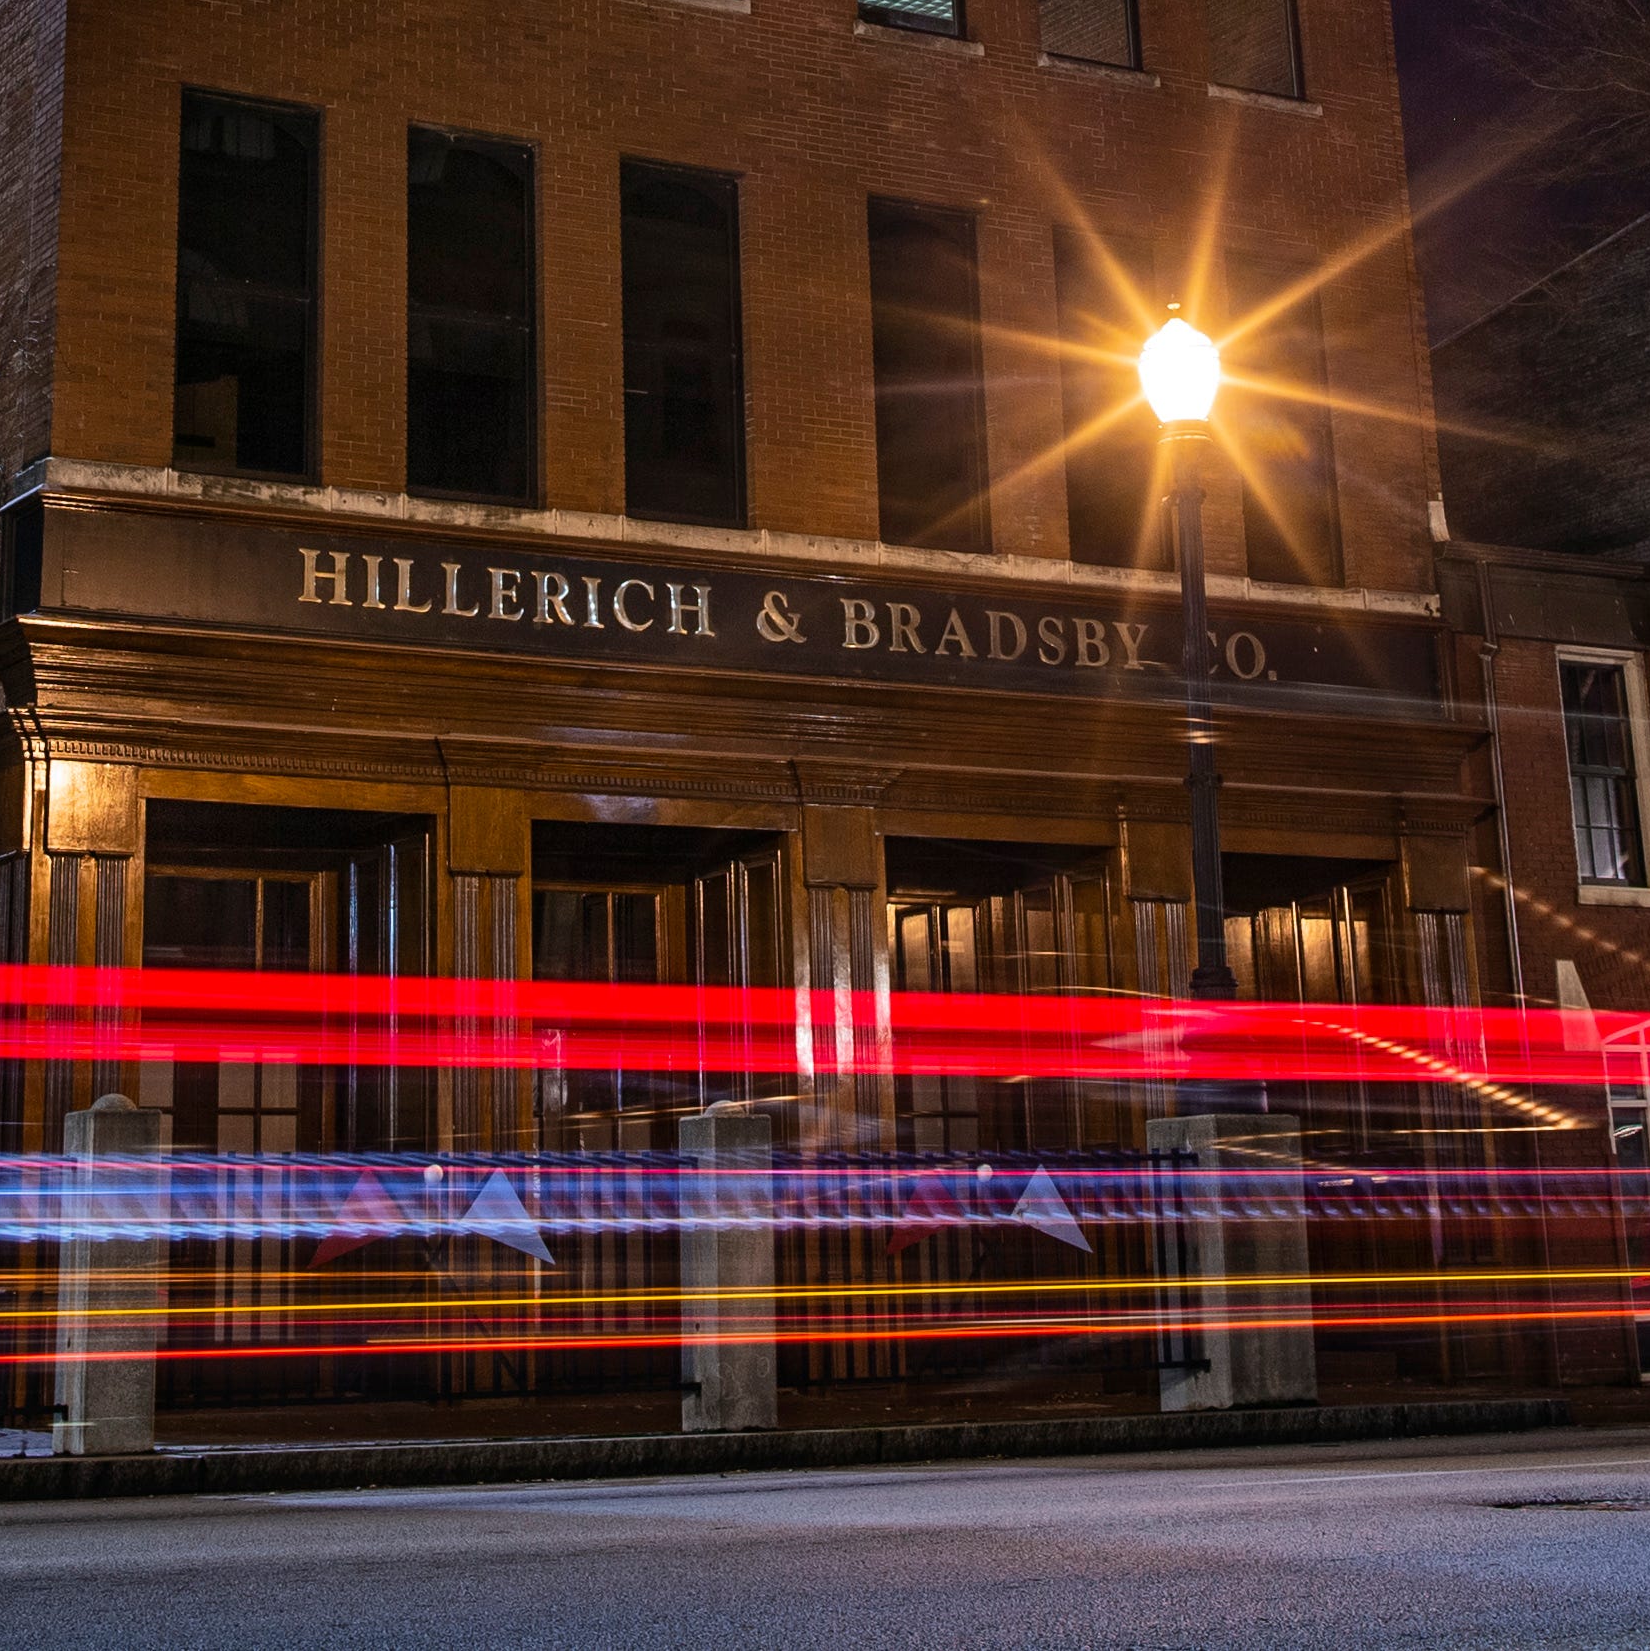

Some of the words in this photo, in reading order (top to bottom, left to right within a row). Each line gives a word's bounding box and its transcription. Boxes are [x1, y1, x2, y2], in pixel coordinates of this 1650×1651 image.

[299, 548, 716, 637] HILLERICH
[756, 591, 807, 643] &
[840, 598, 1149, 670] BRADSBY
